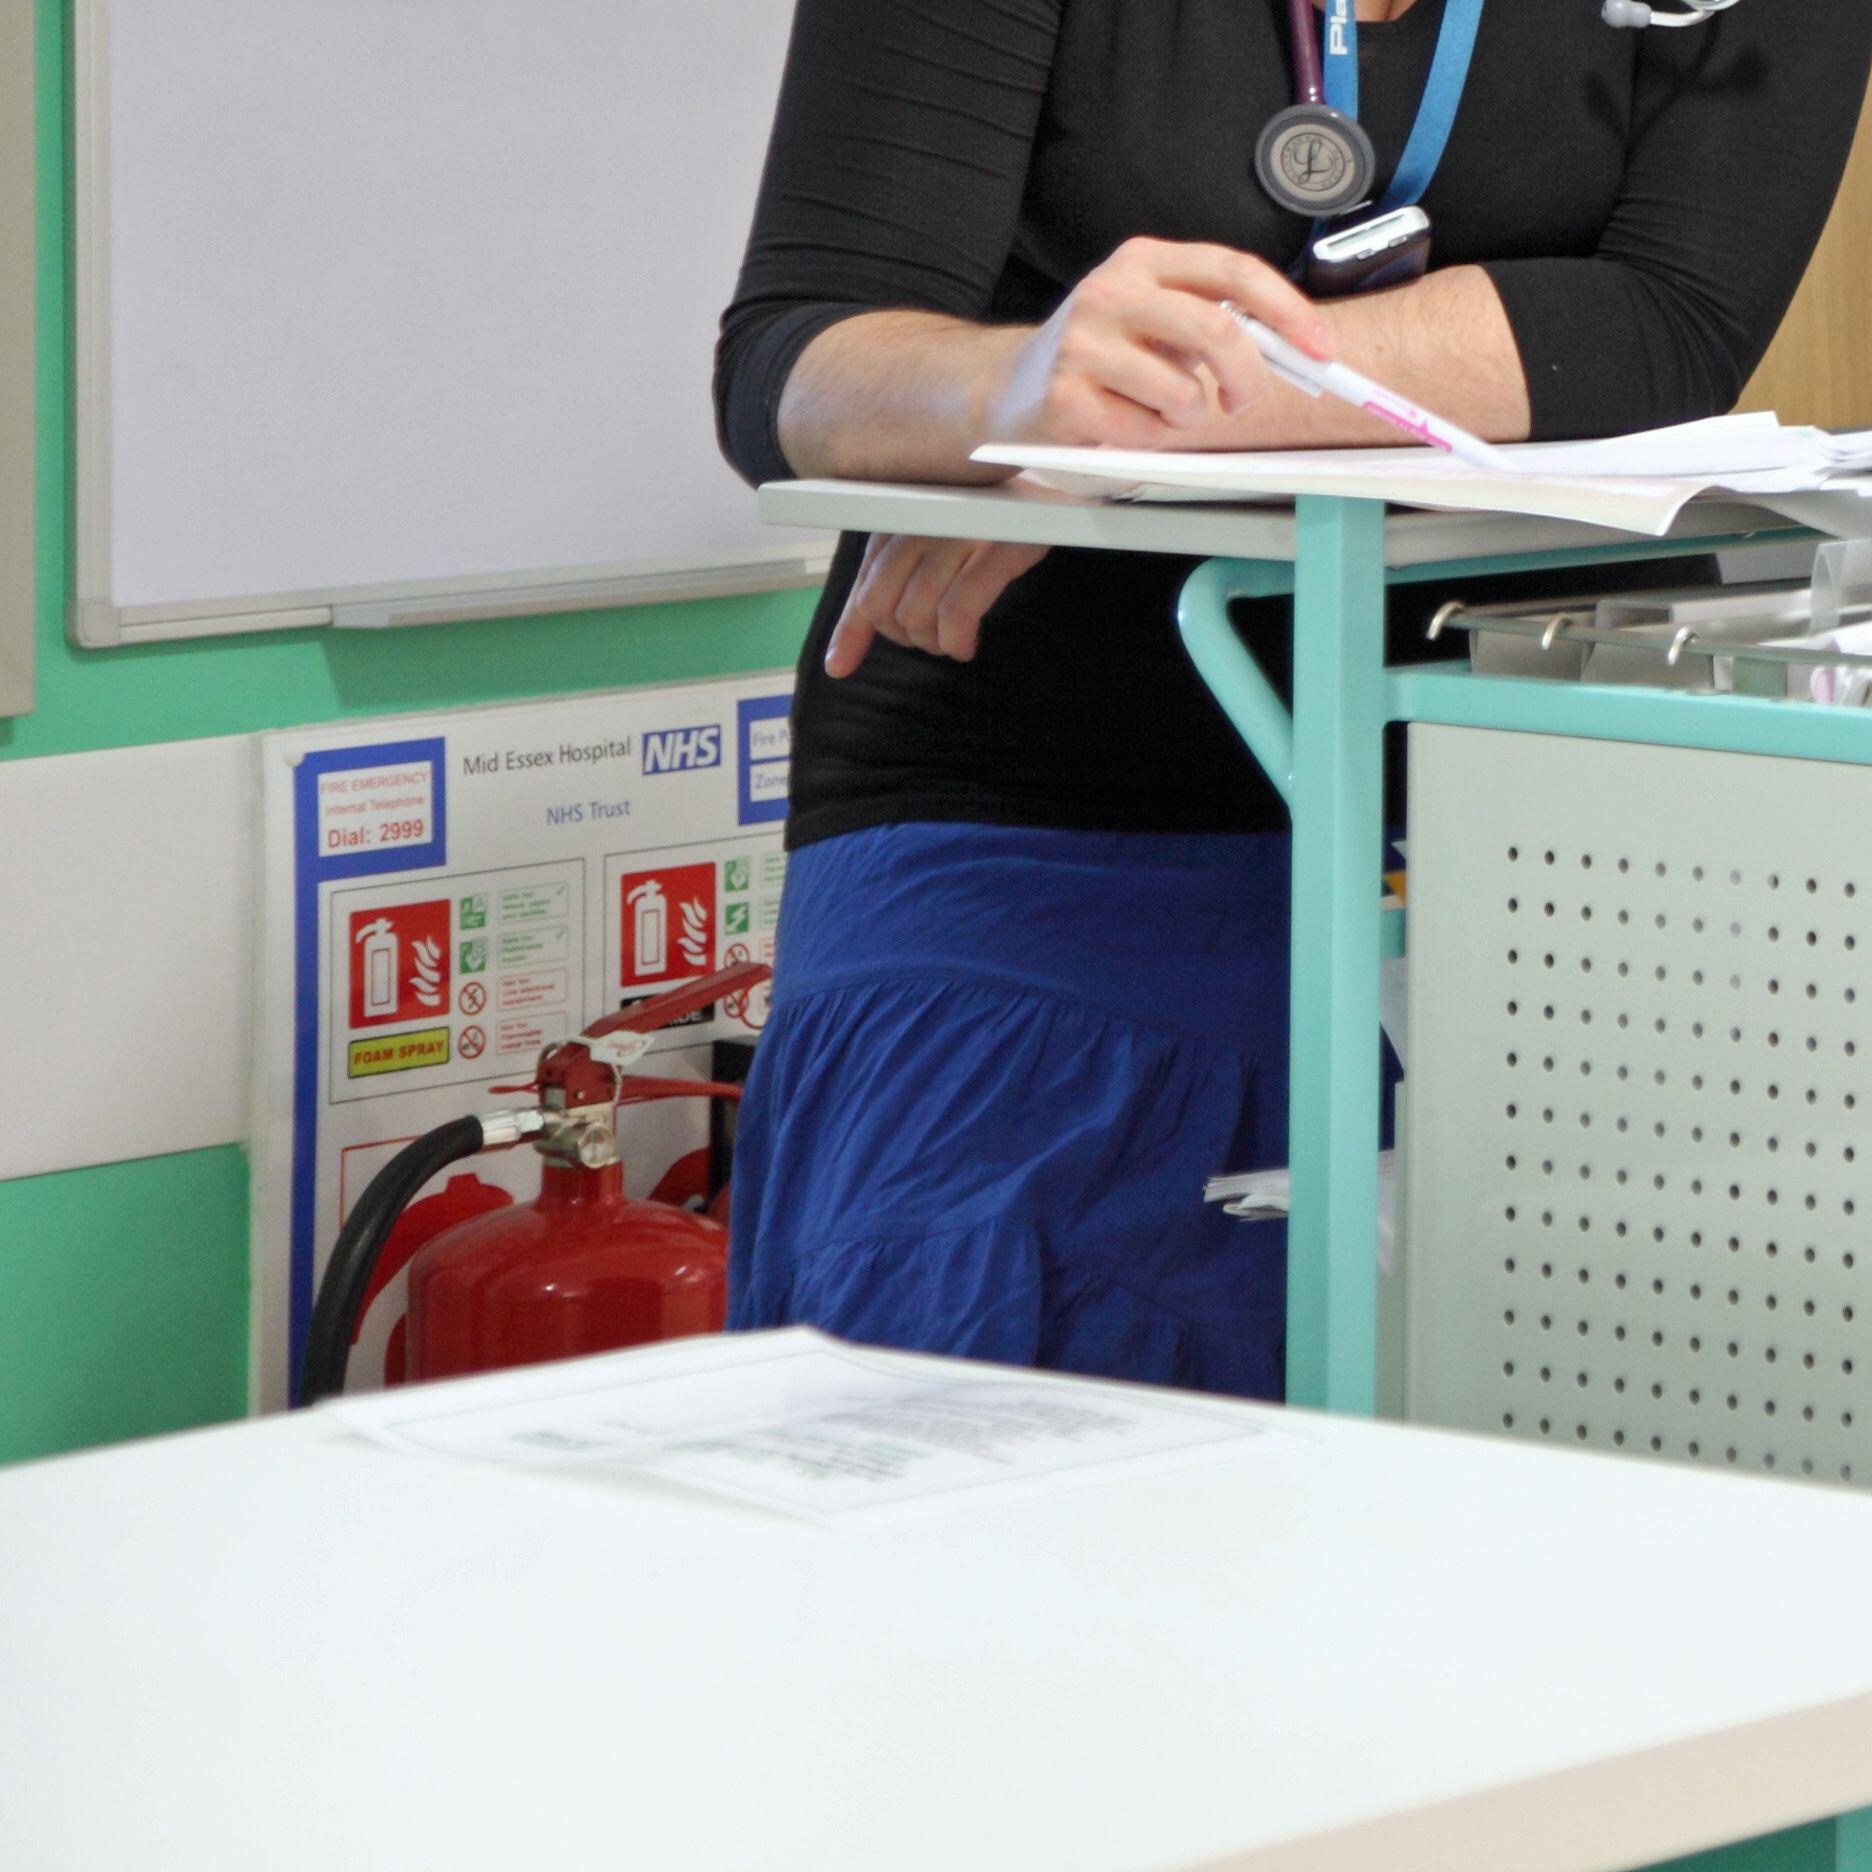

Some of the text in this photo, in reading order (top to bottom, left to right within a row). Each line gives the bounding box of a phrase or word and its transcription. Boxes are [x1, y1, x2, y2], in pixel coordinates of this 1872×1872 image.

[463, 728, 719, 775] Mid Essex Hospital NHS
[351, 771, 429, 792] EMERGENCY
[547, 800, 631, 825] NHS Trust
[328, 819, 423, 848] Dial: 2999
[354, 1039, 444, 1065] FOAM SPRAY
